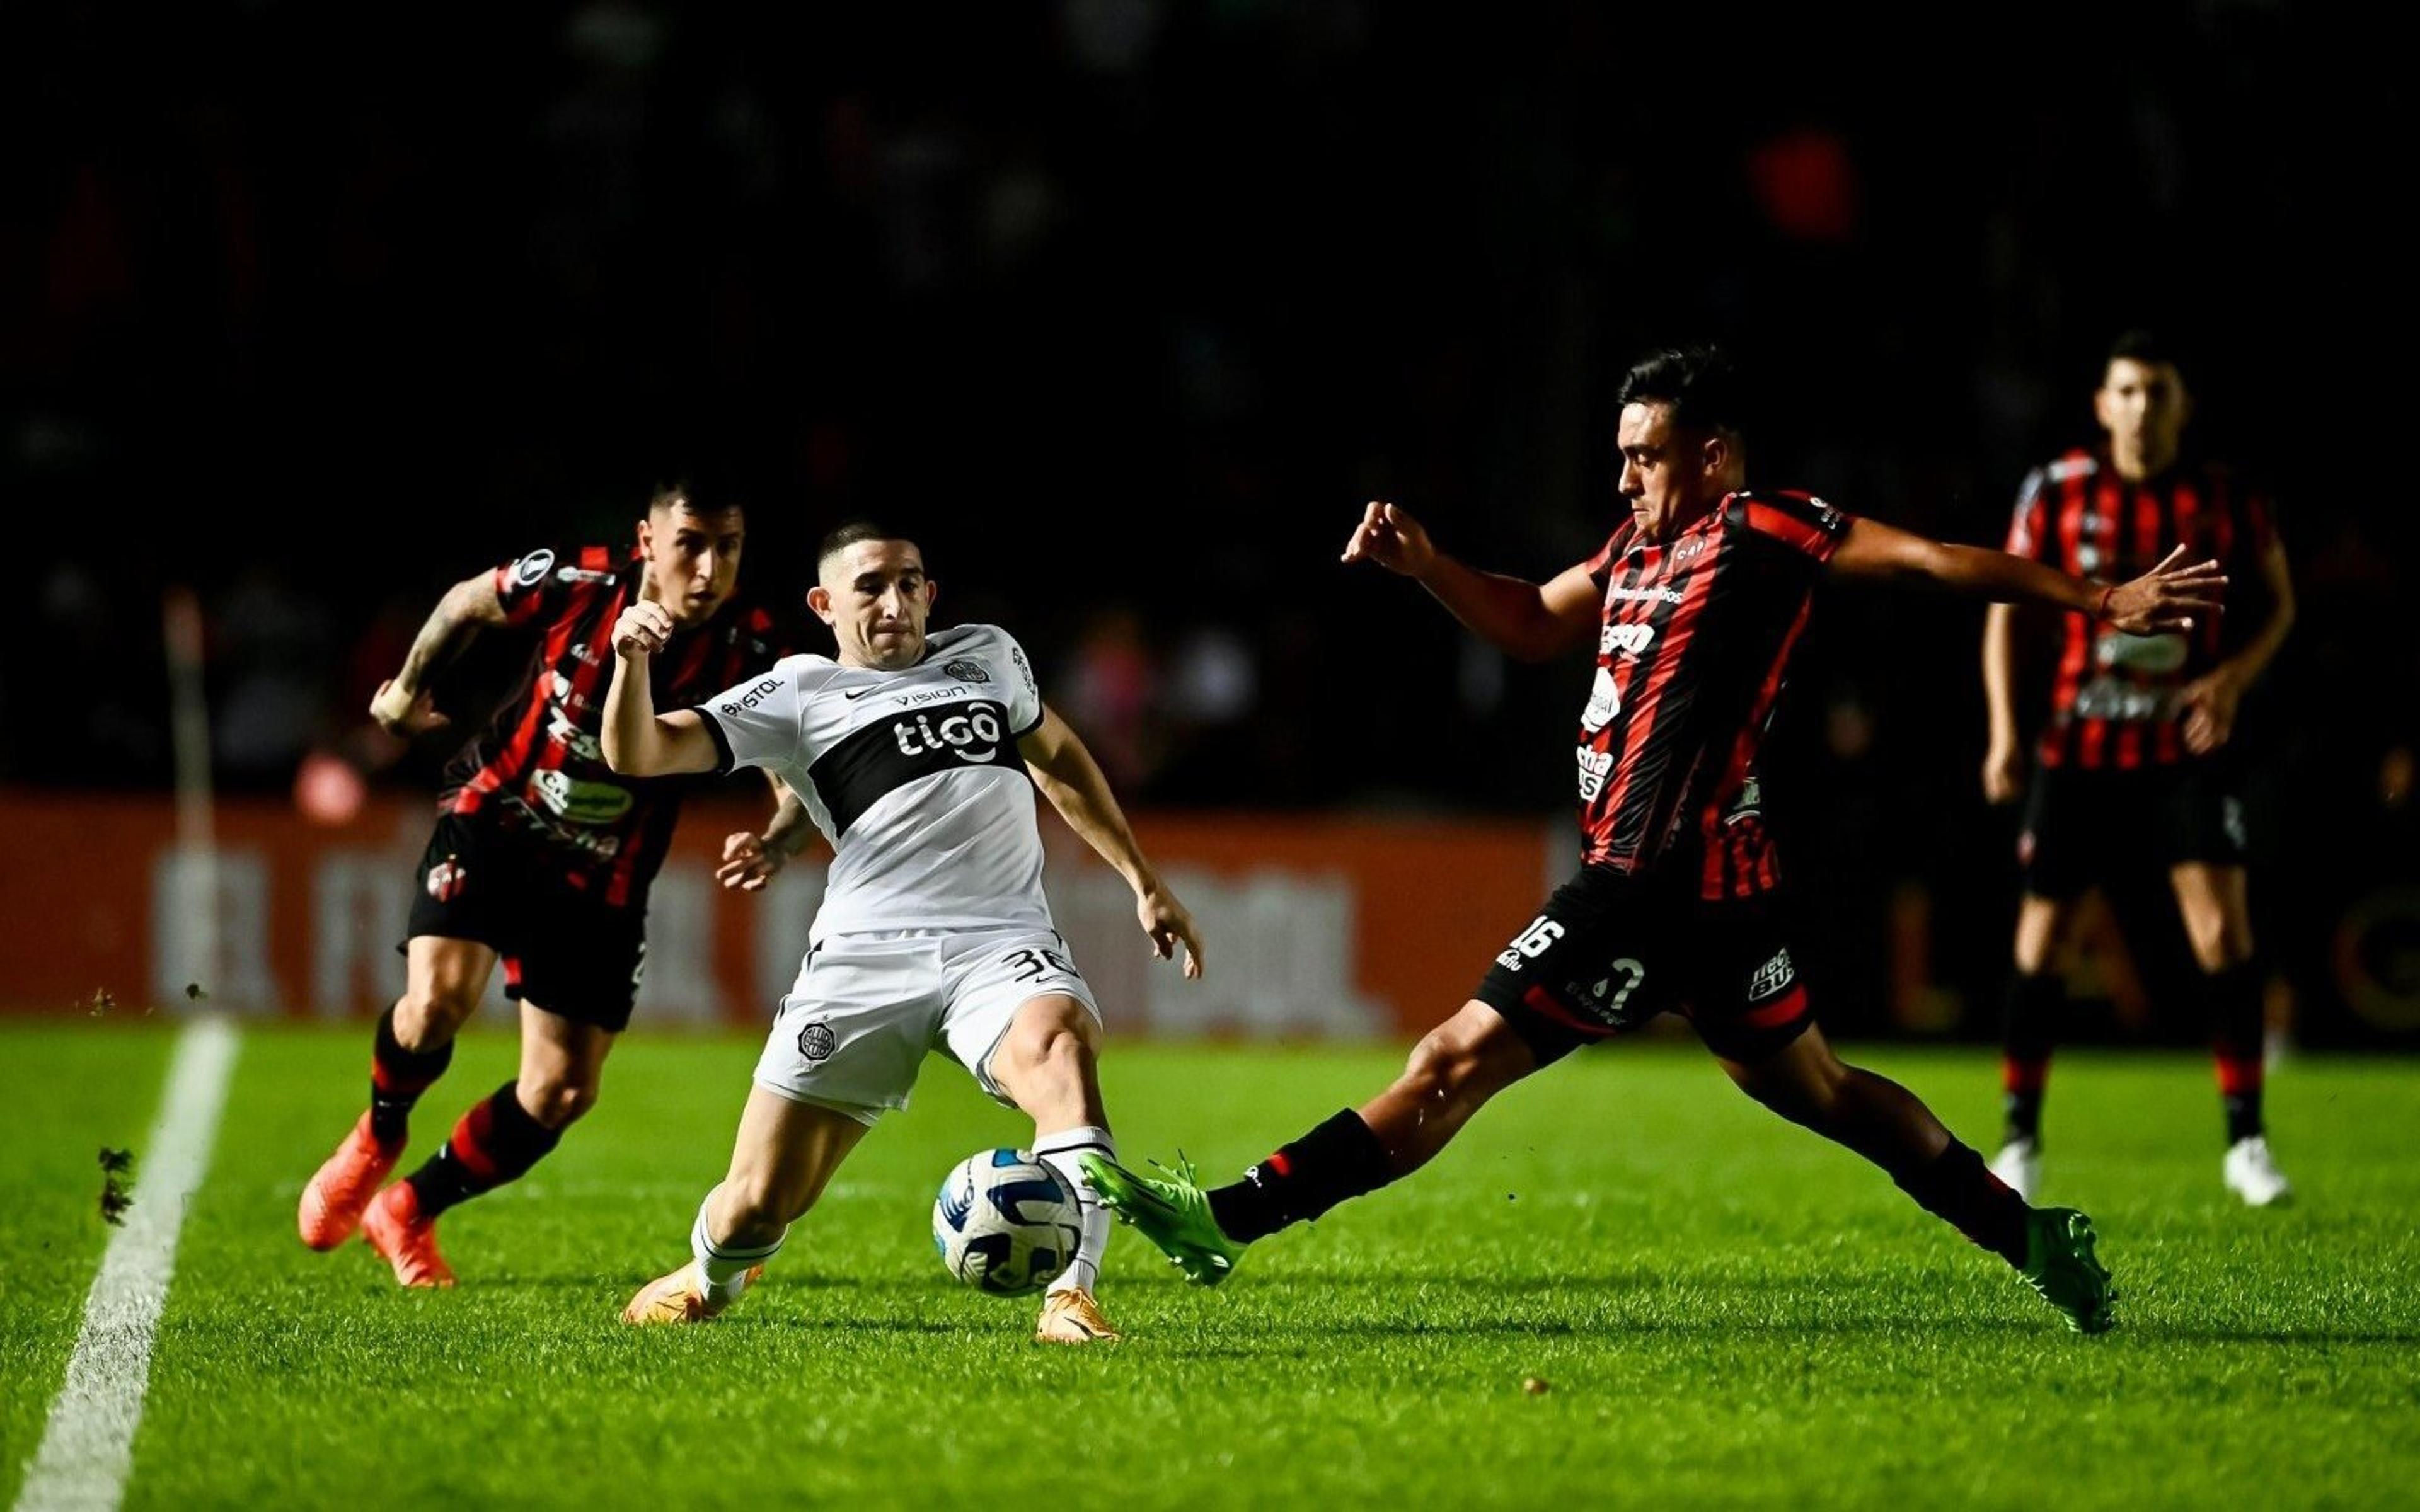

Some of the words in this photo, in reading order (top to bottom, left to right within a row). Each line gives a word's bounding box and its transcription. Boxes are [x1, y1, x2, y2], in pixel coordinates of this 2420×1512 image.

[721, 679, 785, 717] BRISTOL
[894, 709, 1001, 759] tigo
[1509, 915, 1565, 958] 16
